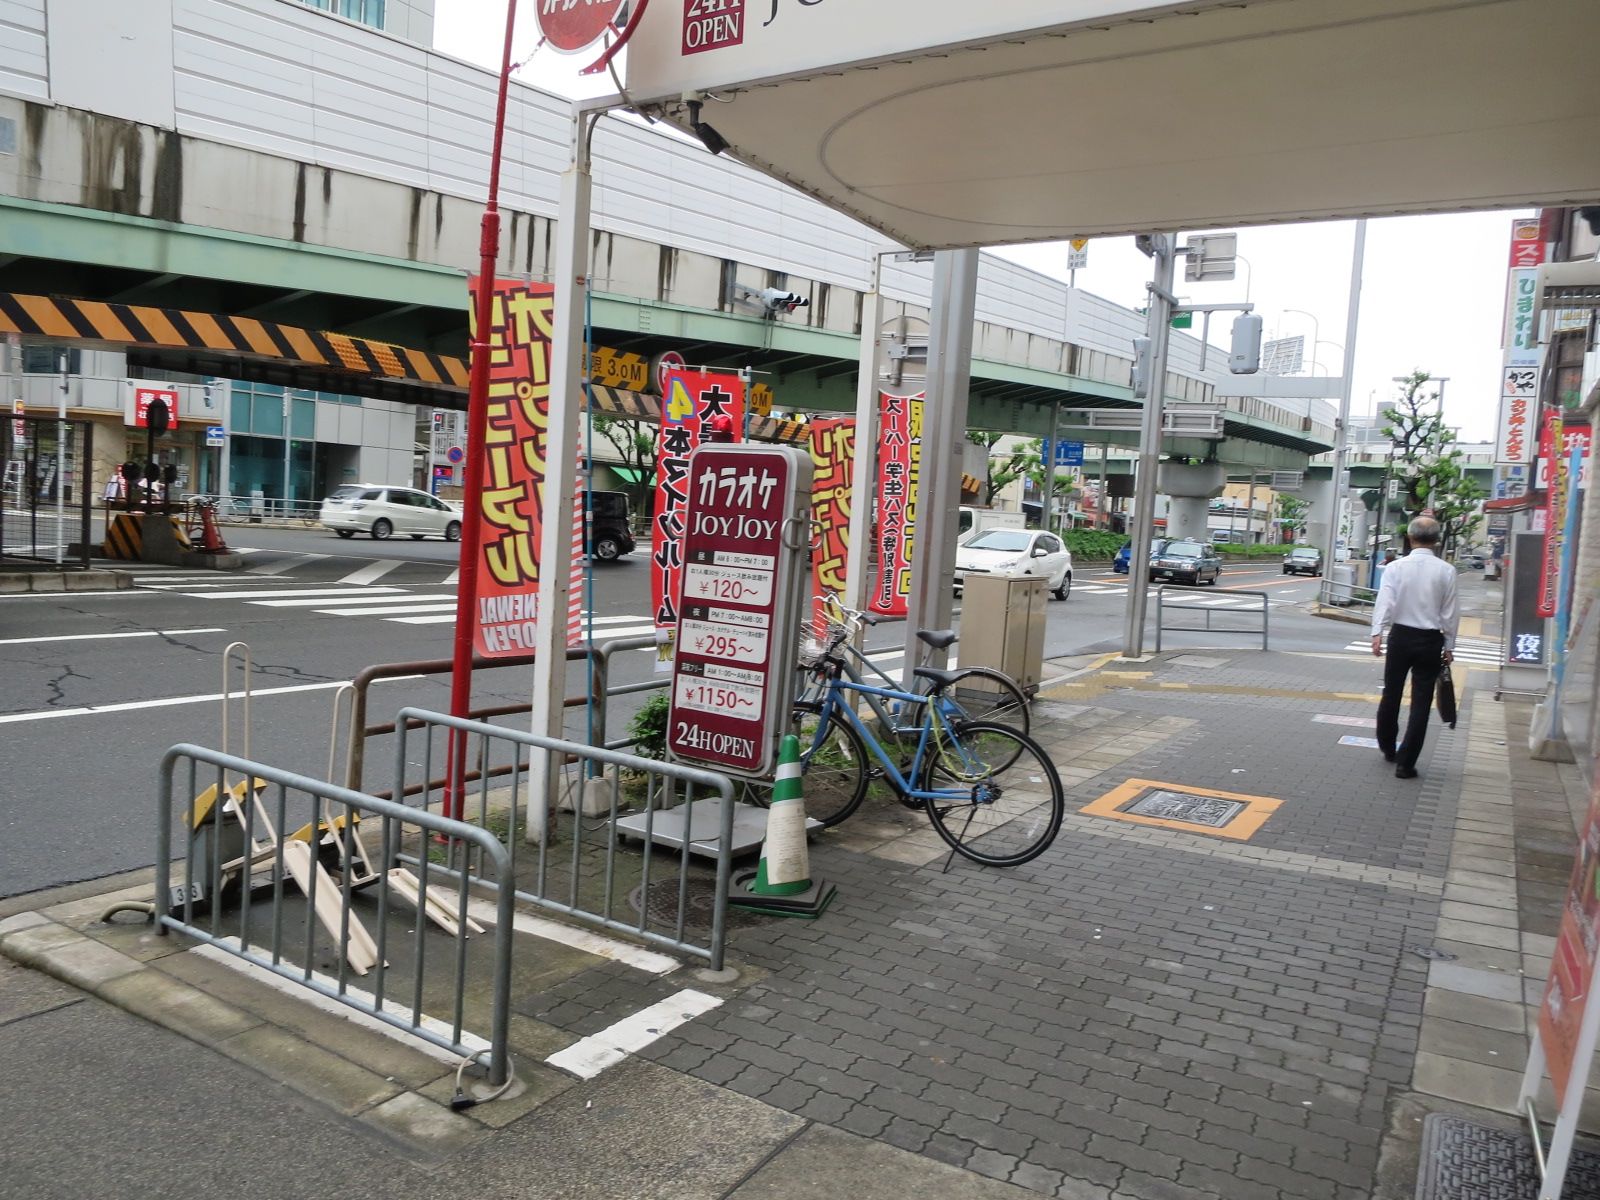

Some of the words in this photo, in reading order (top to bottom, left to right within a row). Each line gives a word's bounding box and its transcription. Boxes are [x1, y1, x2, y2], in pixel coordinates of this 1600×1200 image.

[686, 12, 740, 48] OPEN
[608, 359, 641, 381] 3.0M
[699, 466, 778, 511] カラオケ
